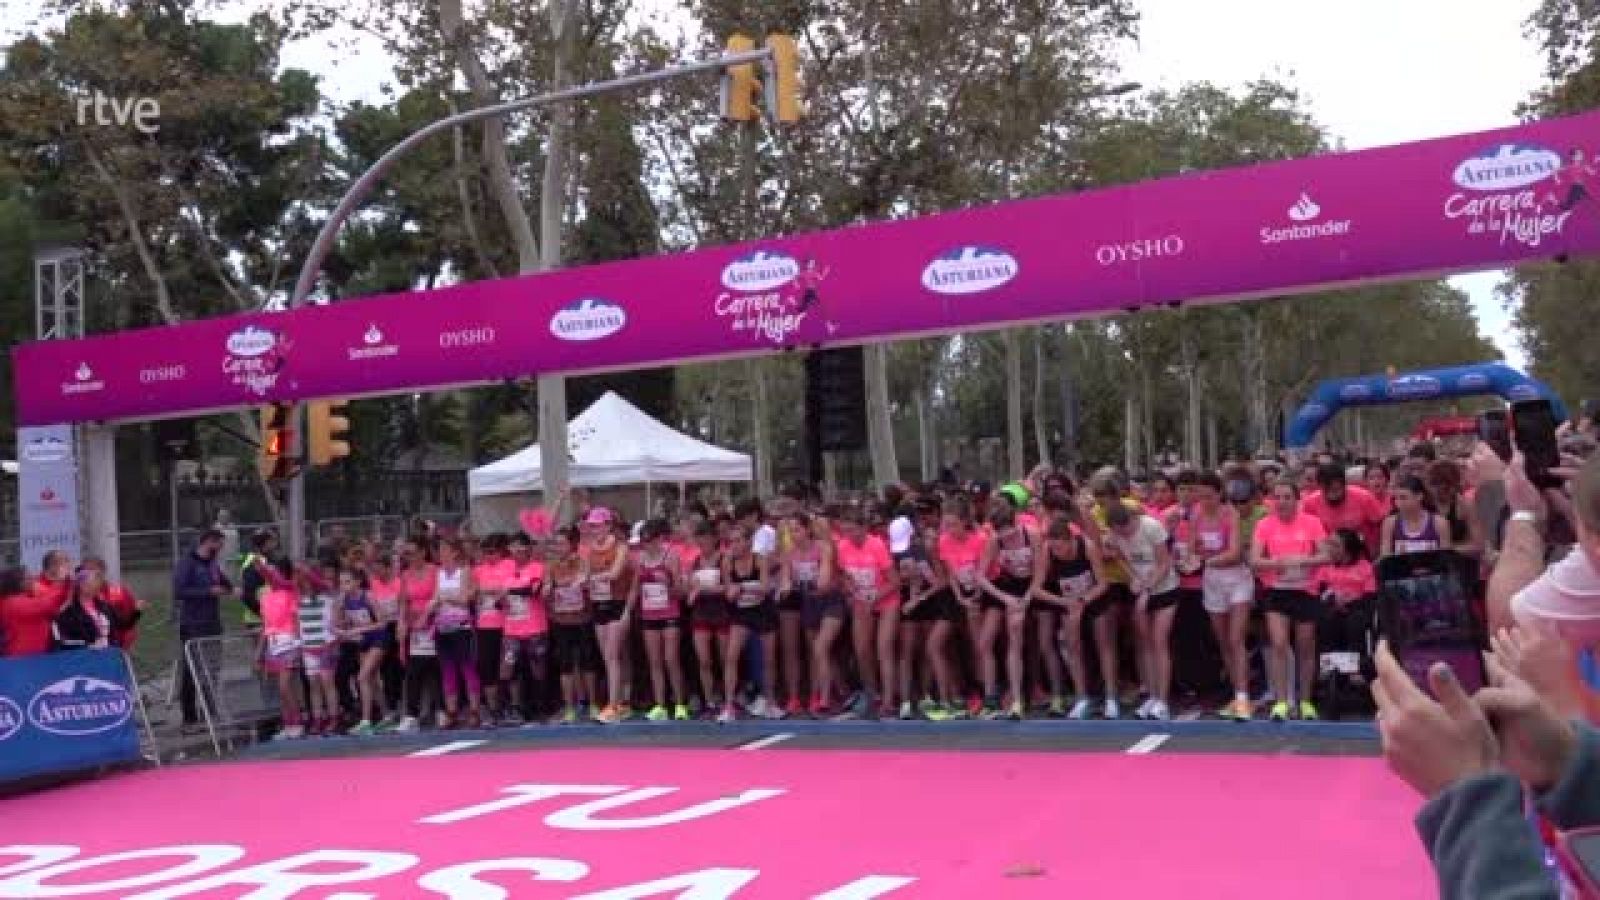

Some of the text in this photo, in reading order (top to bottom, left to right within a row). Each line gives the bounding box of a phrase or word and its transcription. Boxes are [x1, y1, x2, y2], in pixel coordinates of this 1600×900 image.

[1461, 160, 1554, 184] ASTURIANA
[1444, 191, 1541, 219] Carrera
[1259, 220, 1351, 243] Santander
[1500, 207, 1572, 247] Mujer
[1096, 235, 1184, 265] OYSHO
[929, 263, 1012, 286] ASTURIANA
[439, 327, 496, 348] OYSHO
[39, 699, 126, 724] ASTURIANA
[415, 784, 789, 830] TU
